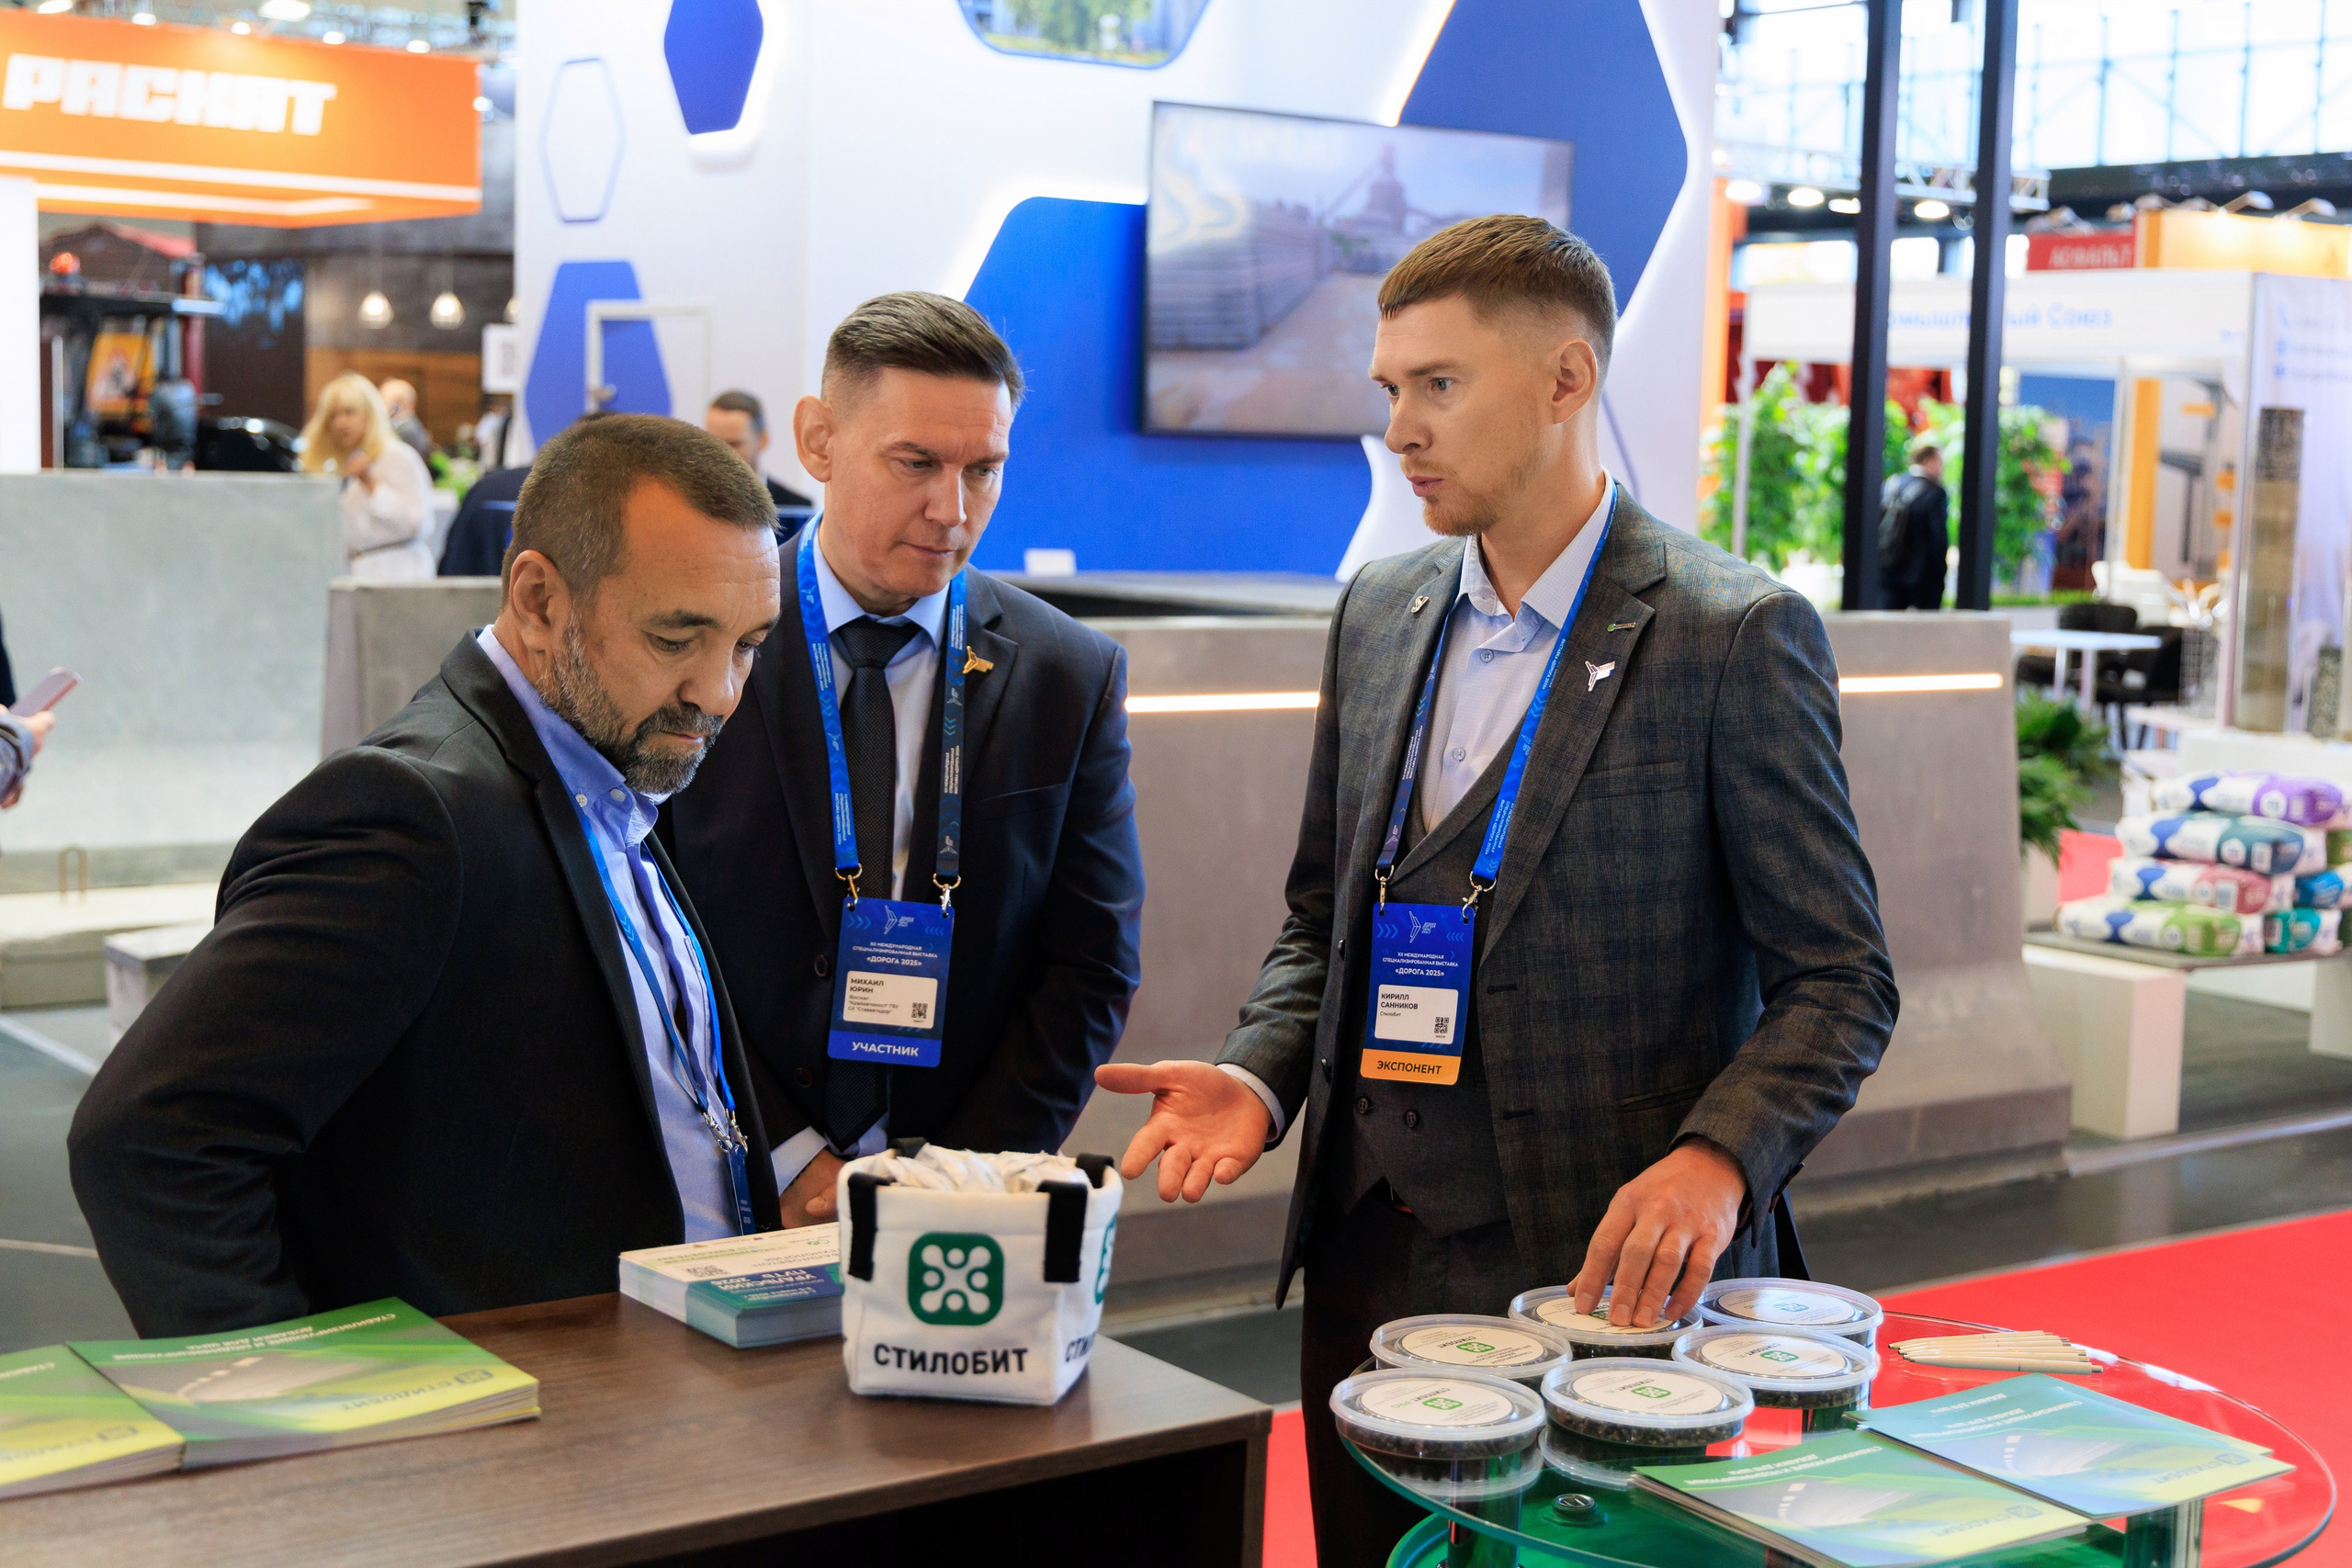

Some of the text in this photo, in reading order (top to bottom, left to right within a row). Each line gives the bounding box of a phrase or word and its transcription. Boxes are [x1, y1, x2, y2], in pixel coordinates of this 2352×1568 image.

[853, 945, 912, 955] СПЕЦИАЛИЗИРОВАННАЯ
[877, 942, 922, 951] МЕЖДУНАРОДНАЯ
[866, 955, 922, 966] «ДОРОГА 2025»
[1382, 957, 1435, 965] СПЕЦИАЛИЗИРОВАННАЯ
[1395, 967, 1424, 976] «ДОРОГА
[851, 978, 885, 987] МИХАИЛ
[1380, 1001, 1419, 1010] САННИКОВ
[852, 1041, 919, 1056] УЧАСТНИК
[1376, 1060, 1442, 1075] ЭКСПОНЕНТ
[762, 1269, 808, 1279] ПУТЬ
[717, 1273, 817, 1292] УРАЛЬСКИЙ
[874, 1343, 1029, 1375] СТИЛОБИТ
